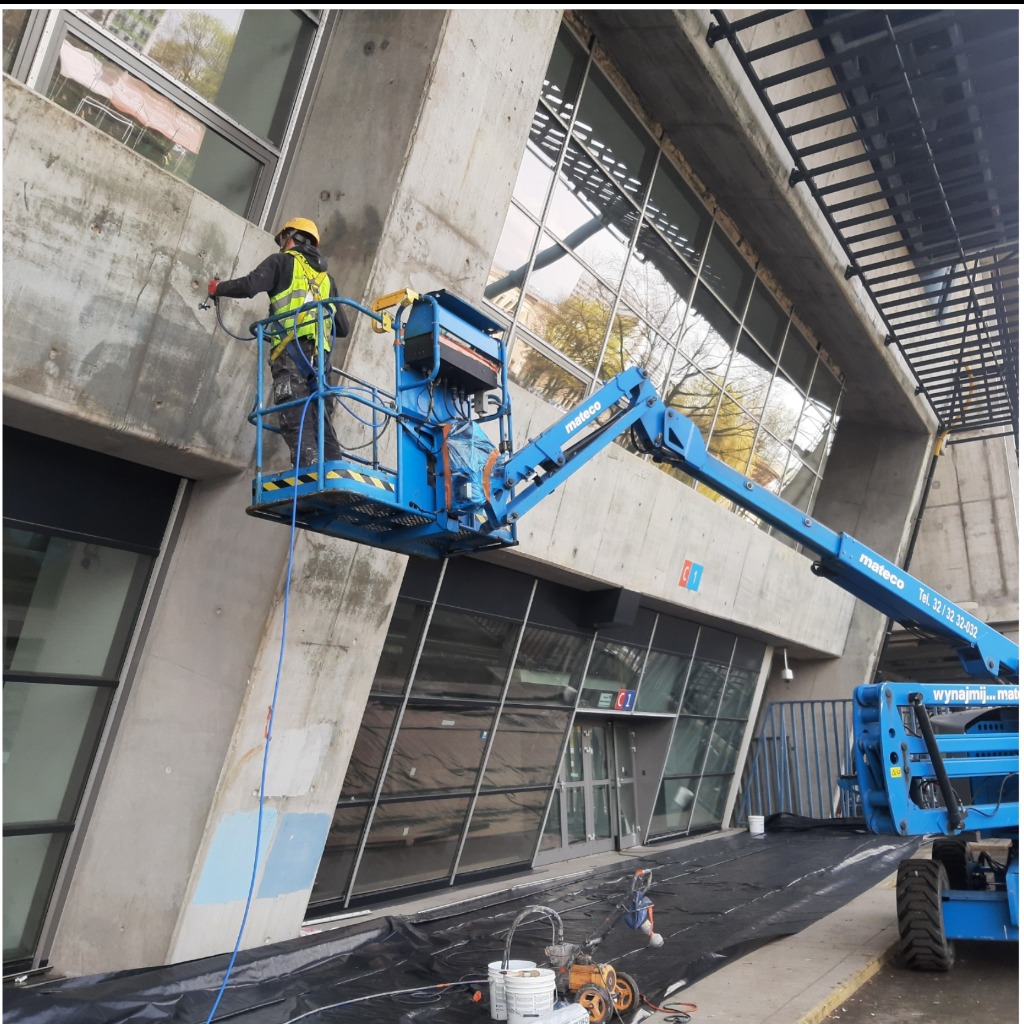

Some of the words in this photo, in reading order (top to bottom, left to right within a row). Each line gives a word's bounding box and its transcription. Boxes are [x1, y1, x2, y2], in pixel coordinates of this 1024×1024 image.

[565, 401, 602, 434] mateco
[859, 553, 905, 590] mateco
[919, 587, 931, 607] Tel.
[933, 598, 942, 614] 32
[946, 607, 956, 623] 32
[956, 614, 979, 639] 32-032
[933, 686, 996, 705] wynajmij...
